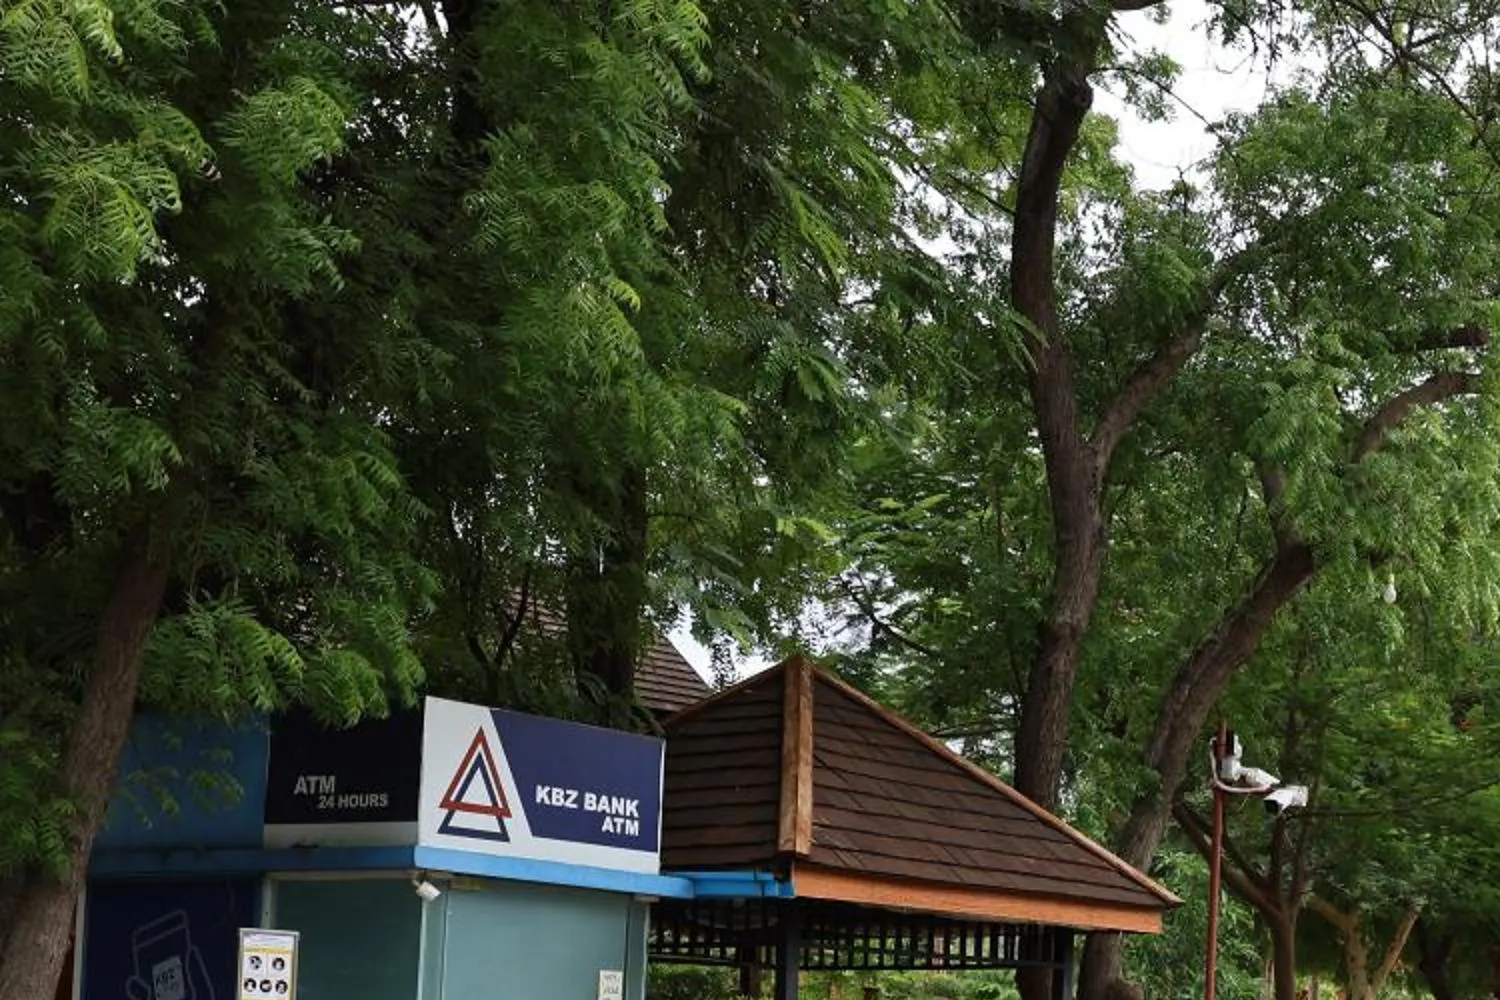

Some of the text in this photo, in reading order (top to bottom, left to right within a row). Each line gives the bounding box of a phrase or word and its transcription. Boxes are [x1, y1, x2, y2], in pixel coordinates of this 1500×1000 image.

[293, 775, 336, 796] ATM
[318, 793, 390, 809] 24 HOURS
[536, 784, 640, 819] KBZ BANK
[601, 816, 640, 837] ATM
